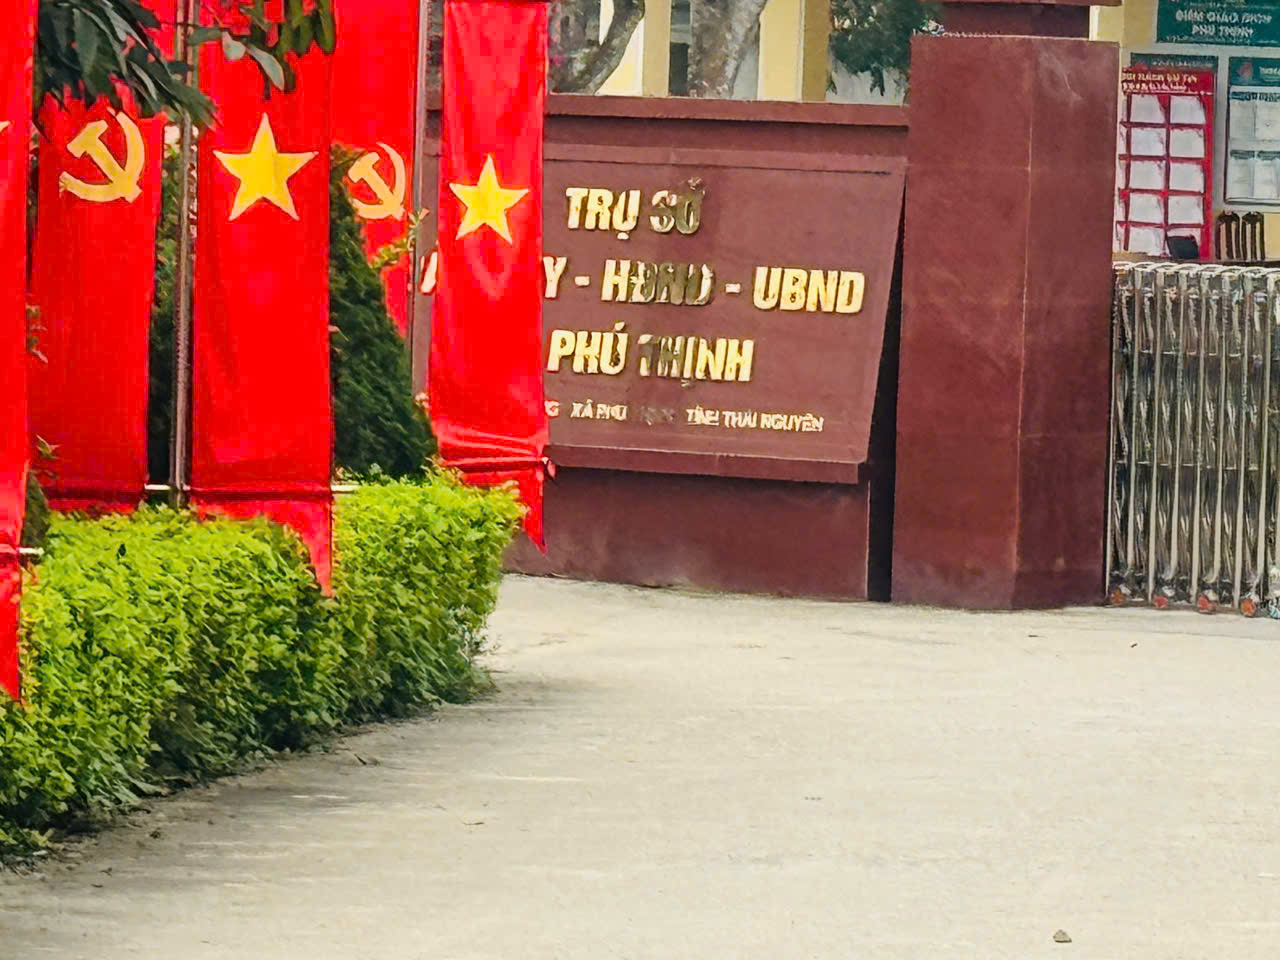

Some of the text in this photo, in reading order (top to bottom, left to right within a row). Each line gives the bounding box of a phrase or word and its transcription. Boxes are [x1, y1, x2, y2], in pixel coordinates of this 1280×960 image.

[566, 176, 706, 240] TRỤ SỞ
[601, 259, 714, 306] HĐND
[753, 266, 865, 314] UBND
[546, 321, 755, 388] PHÚ THỊNH
